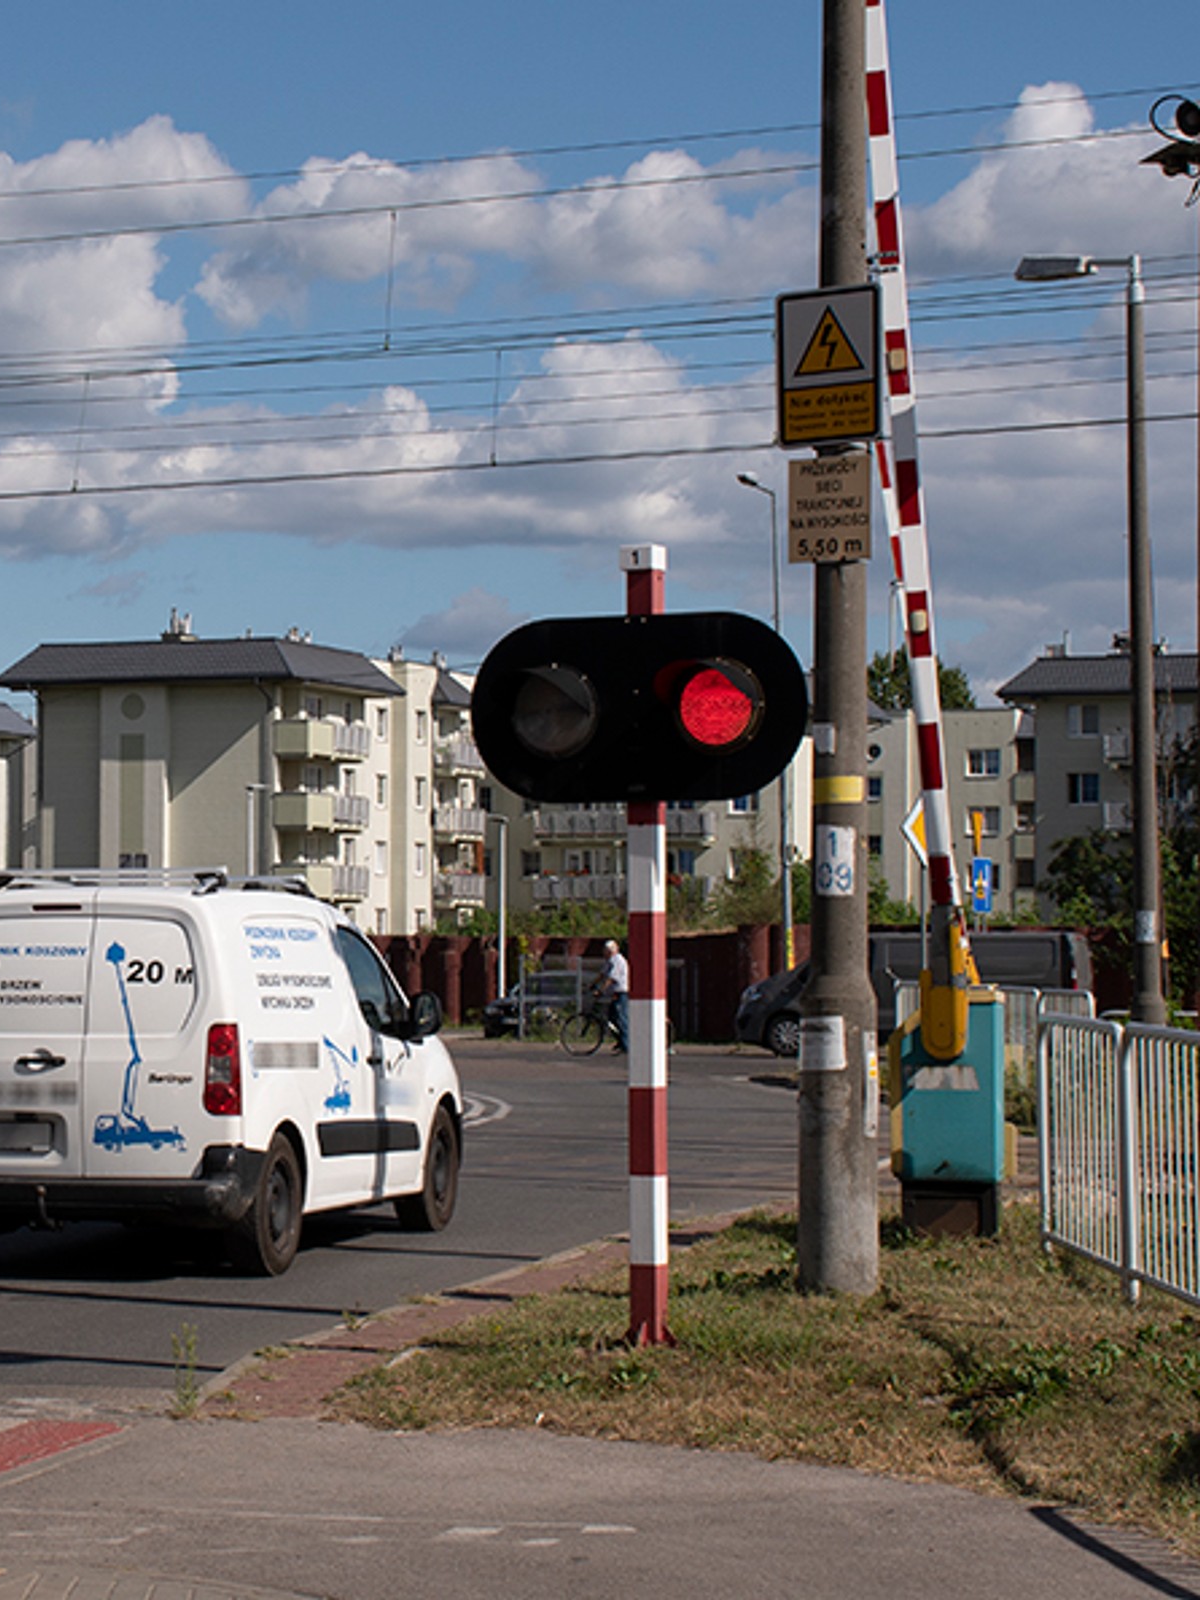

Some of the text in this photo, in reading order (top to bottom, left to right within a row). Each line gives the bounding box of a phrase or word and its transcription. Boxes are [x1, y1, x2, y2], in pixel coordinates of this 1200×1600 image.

[790, 518, 804, 529] NA
[844, 540, 862, 553] m
[631, 549, 639, 566] 1
[828, 831, 836, 857] 1
[25, 946, 87, 956] KOSZOWY
[127, 959, 193, 984] 20 M
[0, 980, 41, 990] DRZEW
